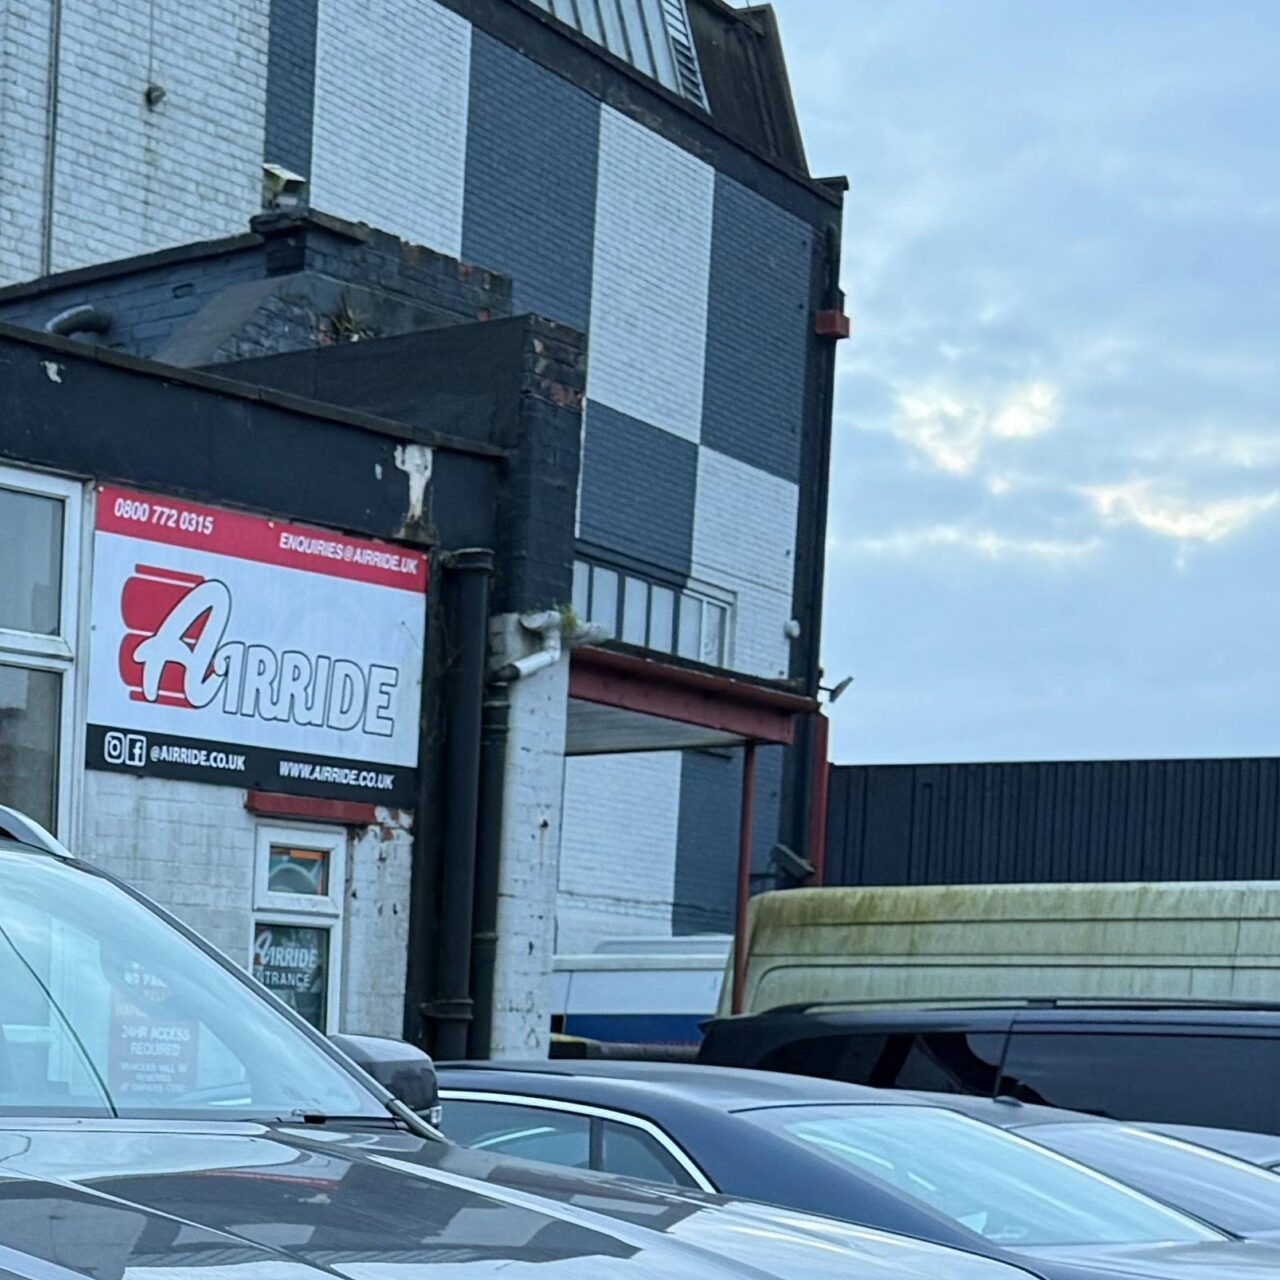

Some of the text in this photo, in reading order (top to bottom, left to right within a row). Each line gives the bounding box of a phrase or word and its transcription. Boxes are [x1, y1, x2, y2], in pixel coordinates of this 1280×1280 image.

[114, 498, 214, 535] 0800 772 0315
[279, 532, 418, 574] ENQUIRIES@AIRRIDE.UK
[132, 578, 400, 738] AIRRIDE
[150, 745, 246, 771] @AIRRIDE.CO.UK
[279, 760, 395, 790] WWW.AIRRIDE.CO.UK
[255, 970, 311, 988] NTRANCE
[150, 1026, 190, 1041] ACCESS
[130, 1041, 180, 1056] REQUIRED
